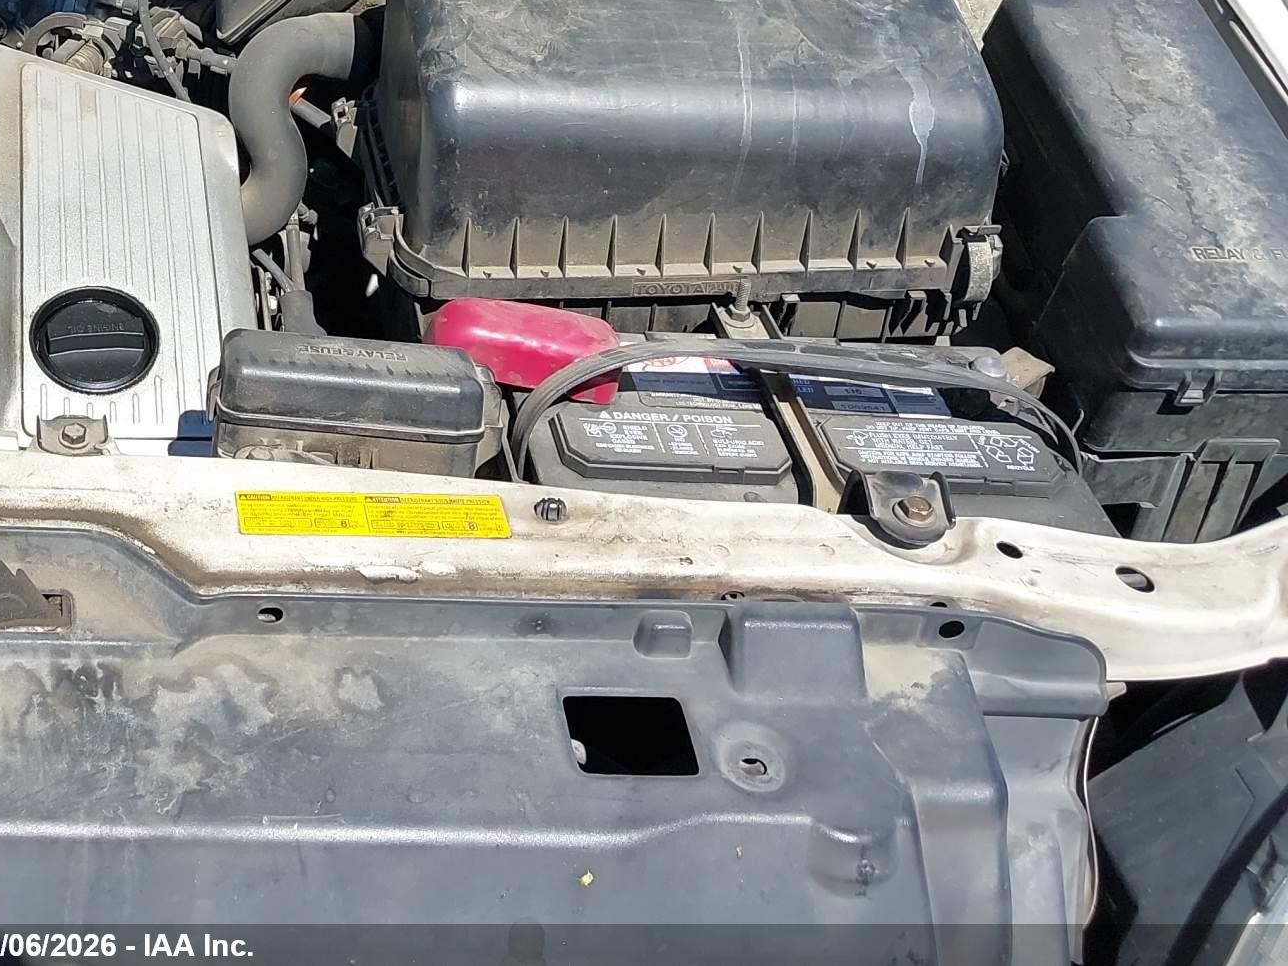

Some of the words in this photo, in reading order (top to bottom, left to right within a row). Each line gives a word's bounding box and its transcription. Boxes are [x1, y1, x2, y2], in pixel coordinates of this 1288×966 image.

[1191, 247, 1246, 260] RELAY
[1253, 247, 1266, 260] &
[357, 348, 409, 362] RELAY
[612, 411, 672, 422] DANGER
[682, 414, 734, 424] POISON
